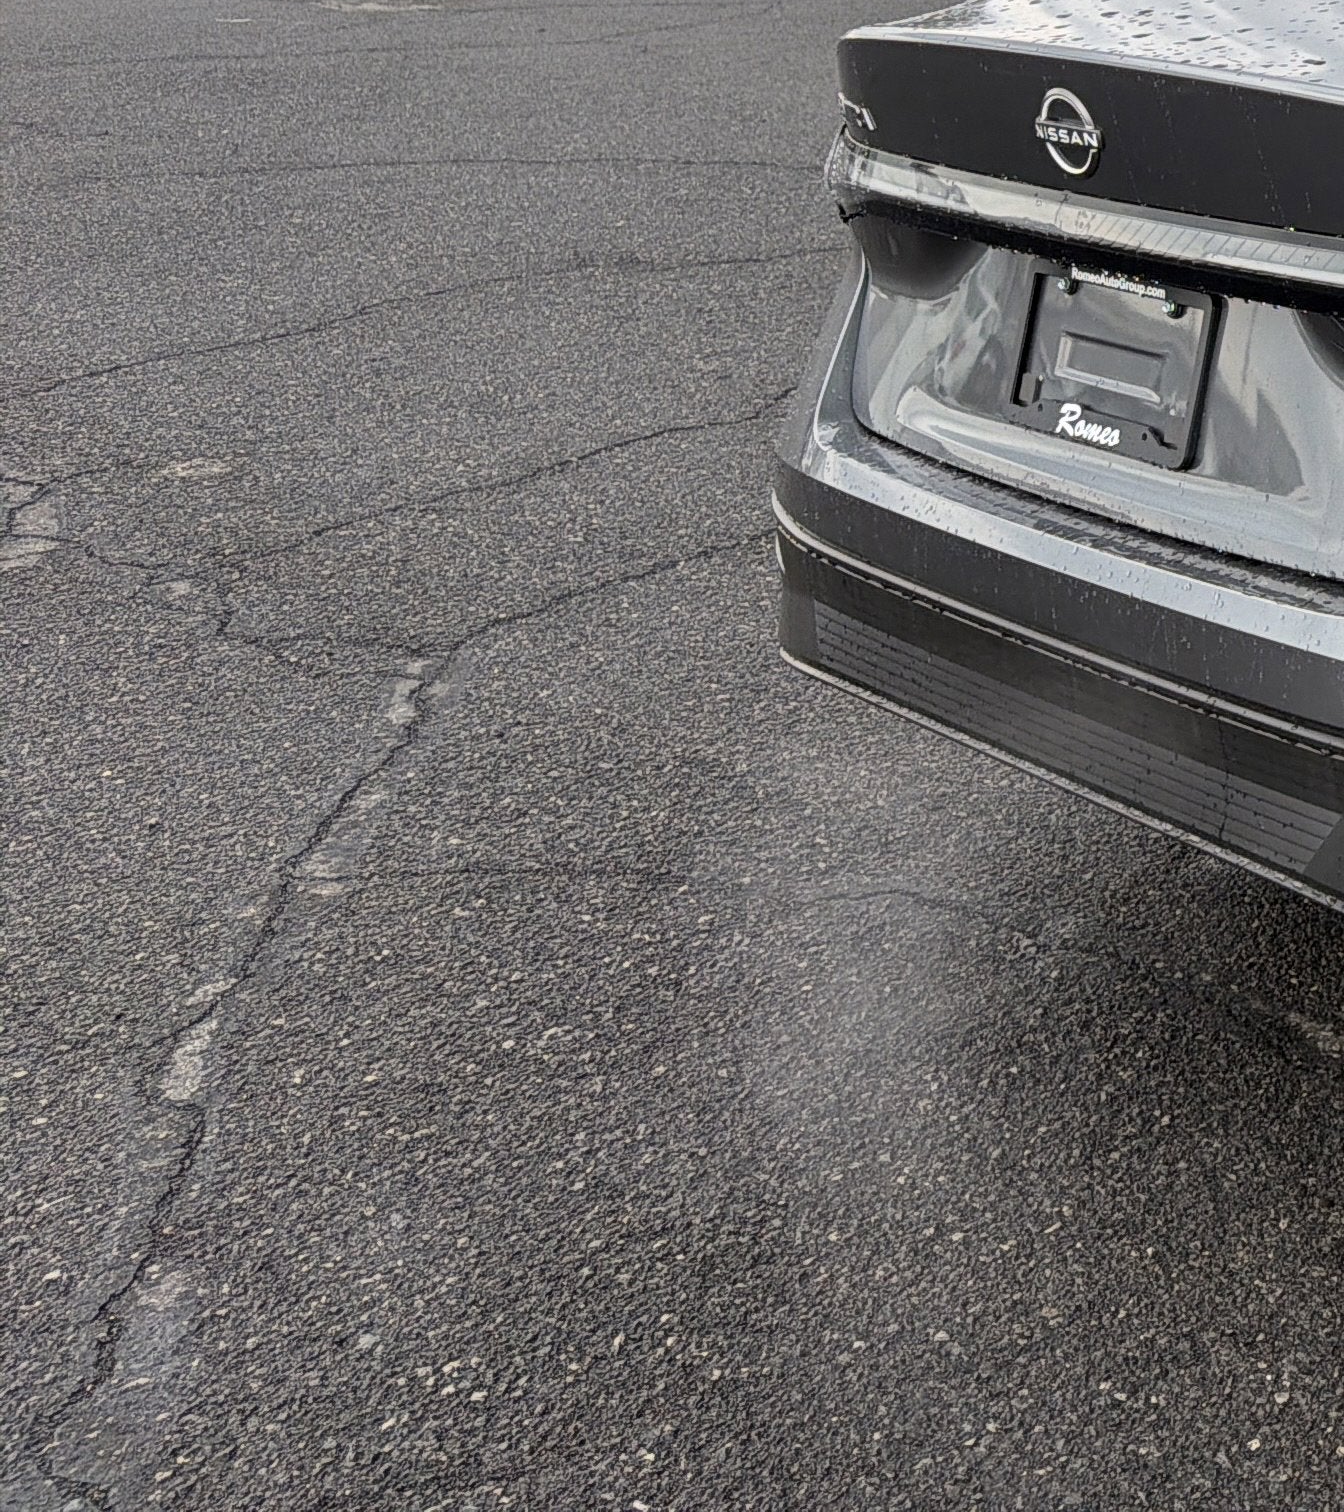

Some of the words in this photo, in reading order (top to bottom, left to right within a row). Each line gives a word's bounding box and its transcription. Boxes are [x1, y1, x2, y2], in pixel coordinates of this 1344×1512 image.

[1034, 123, 1099, 148] NISSAN
[1071, 266, 1167, 300] RomeoAutoGroup.com
[1055, 402, 1121, 447] Romeo
